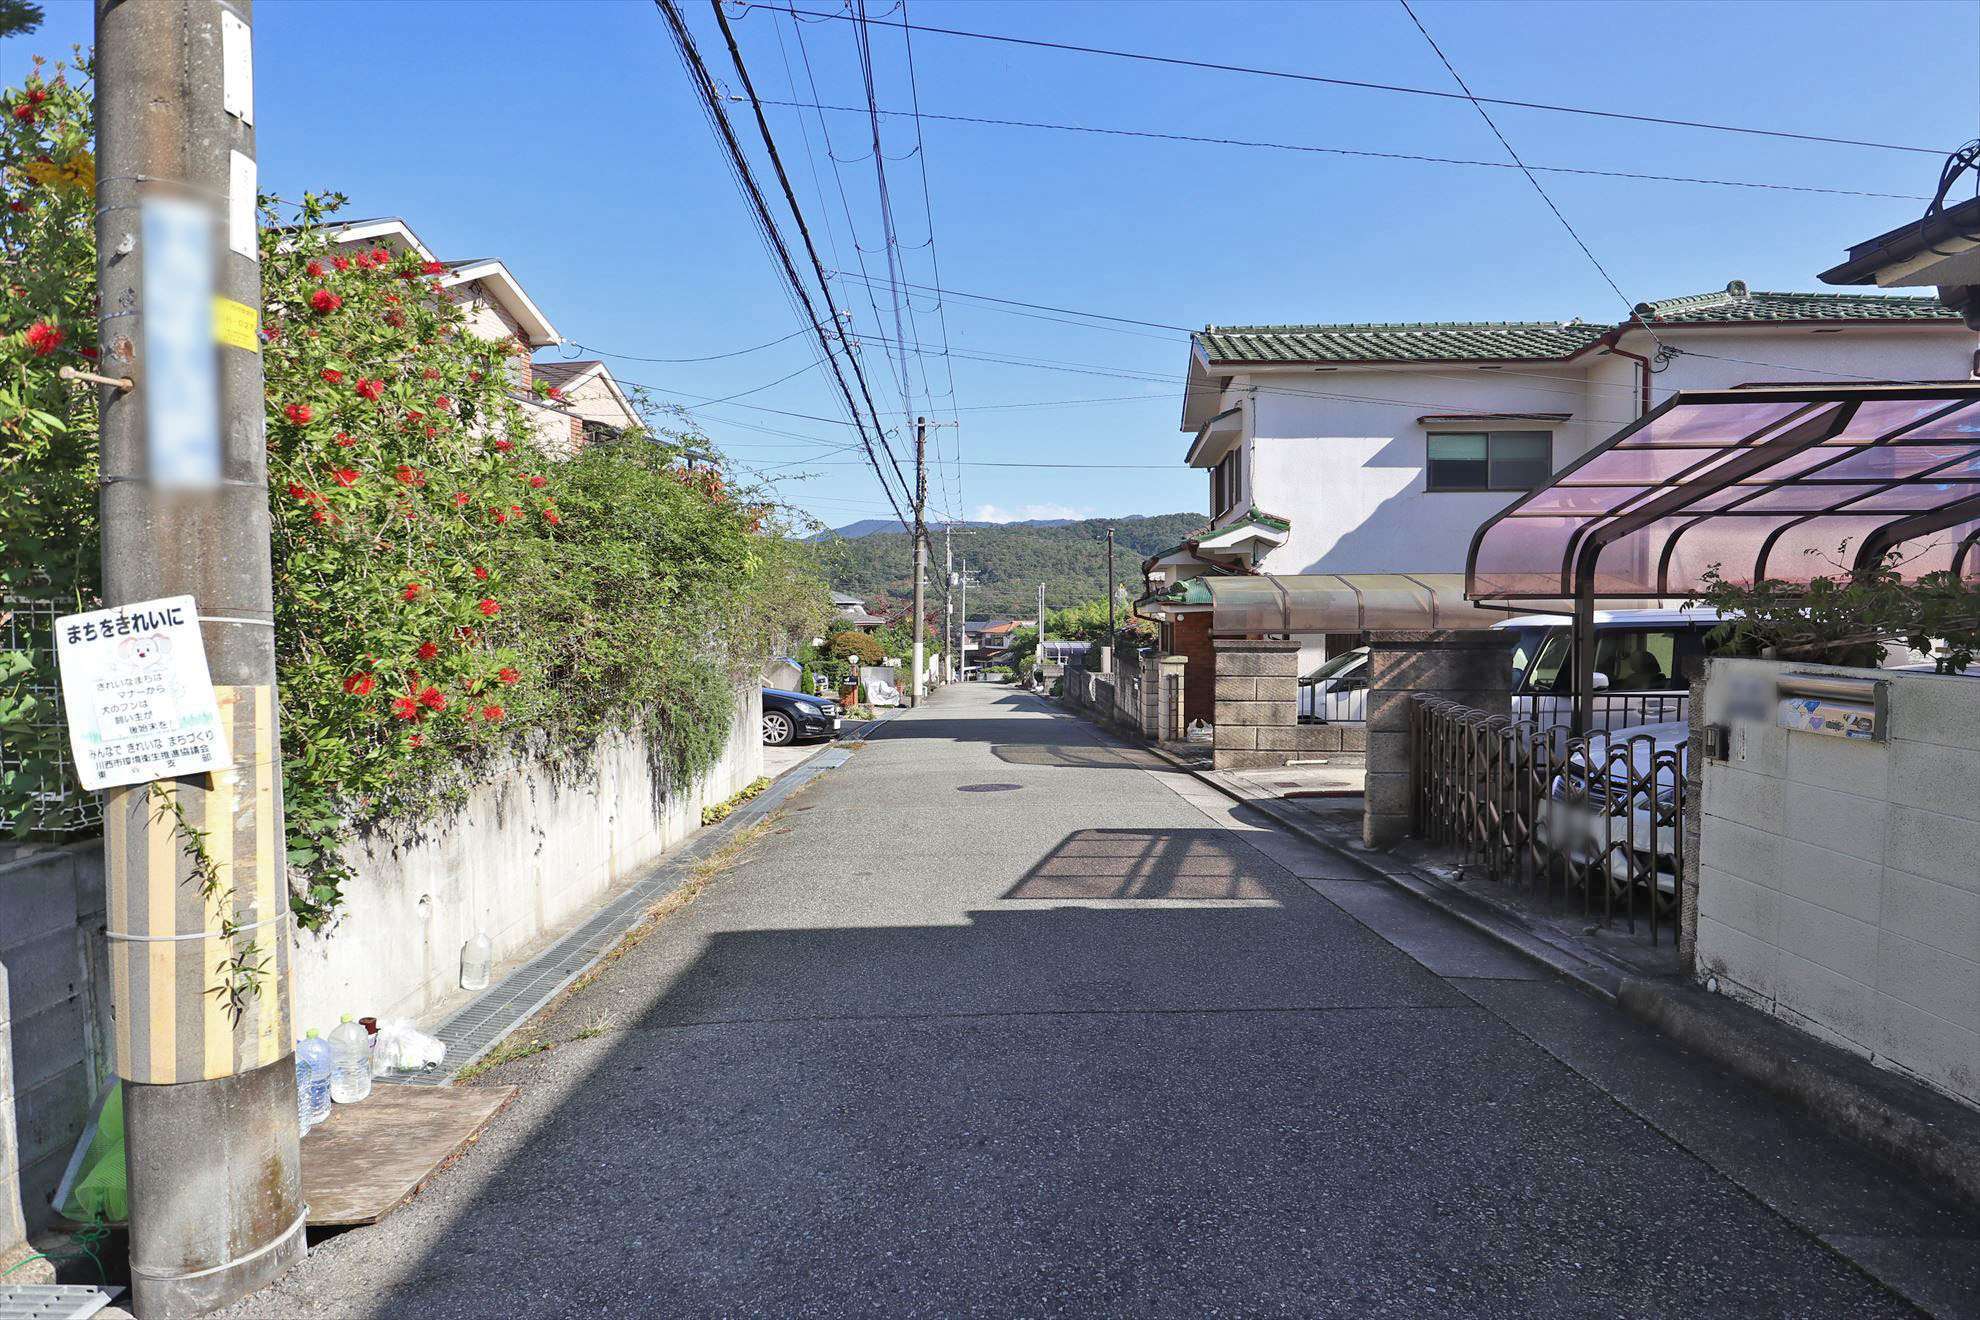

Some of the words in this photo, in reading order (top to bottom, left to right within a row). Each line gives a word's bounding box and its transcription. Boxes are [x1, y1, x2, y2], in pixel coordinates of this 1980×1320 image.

[67, 607, 185, 644] まちをきれいに
[96, 673, 163, 691] きれいなまちは
[117, 687, 165, 699] マナーから
[102, 700, 149, 715] 犬のフンは
[115, 710, 153, 725] 飼い主が
[89, 743, 124, 759] みんなで
[127, 739, 163, 754] きれいな
[169, 729, 215, 747] まちづくり
